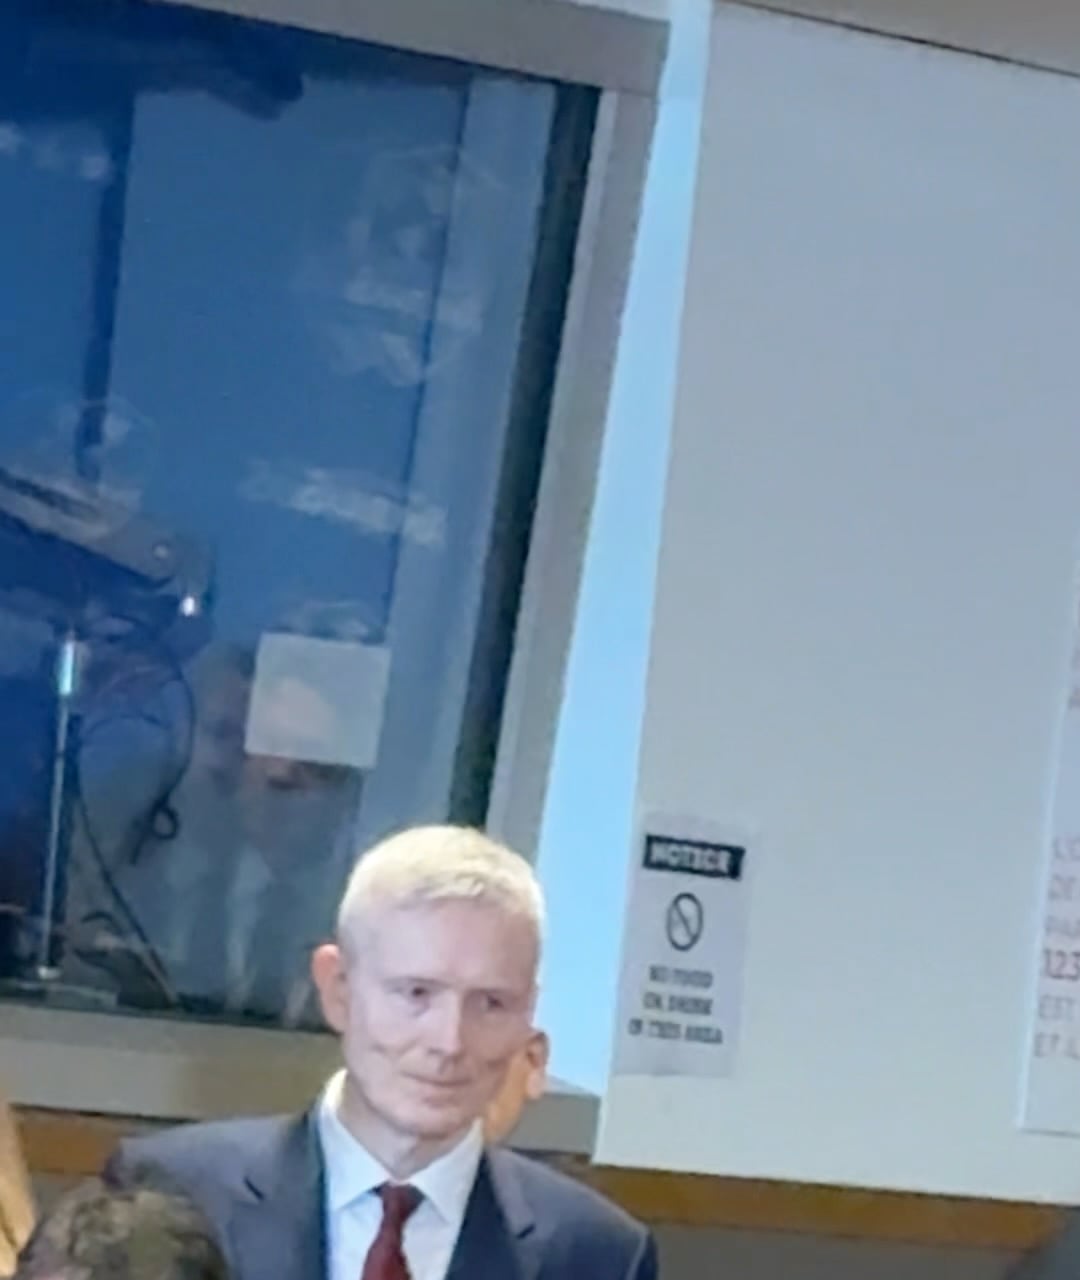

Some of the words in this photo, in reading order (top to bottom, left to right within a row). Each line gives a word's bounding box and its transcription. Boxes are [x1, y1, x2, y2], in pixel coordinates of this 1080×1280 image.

[650, 841, 732, 874] NOTICE
[1047, 873, 1077, 901] DE
[1038, 994, 1075, 1021] EST
[1034, 1032, 1061, 1058] ET
